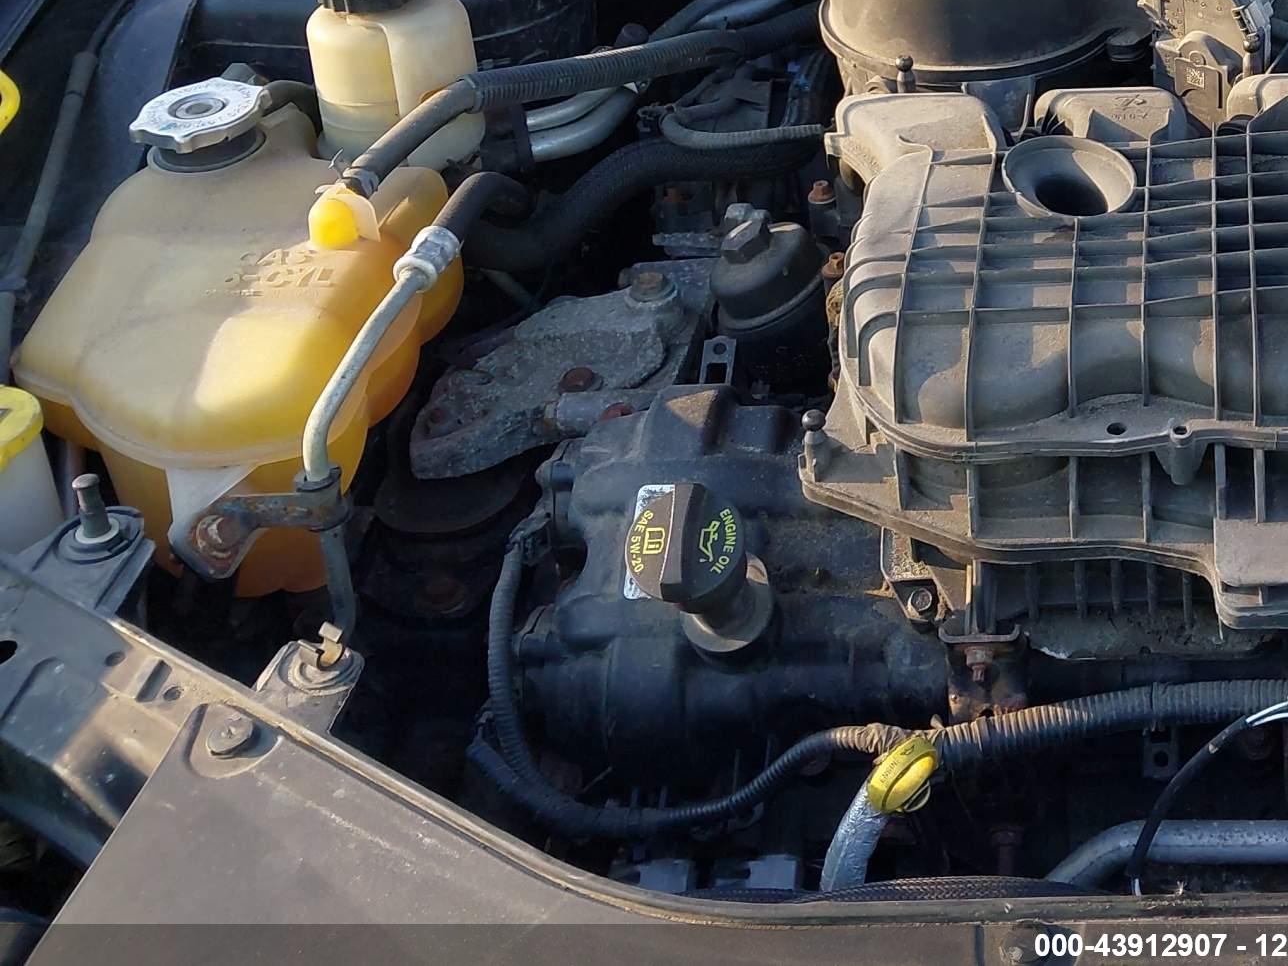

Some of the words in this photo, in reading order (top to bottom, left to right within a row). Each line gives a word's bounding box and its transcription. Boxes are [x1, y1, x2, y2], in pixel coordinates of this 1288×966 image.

[634, 509, 654, 534] SAE
[719, 507, 738, 554] ENGINE
[629, 535, 645, 573] 5W-20
[709, 554, 731, 575] OIL
